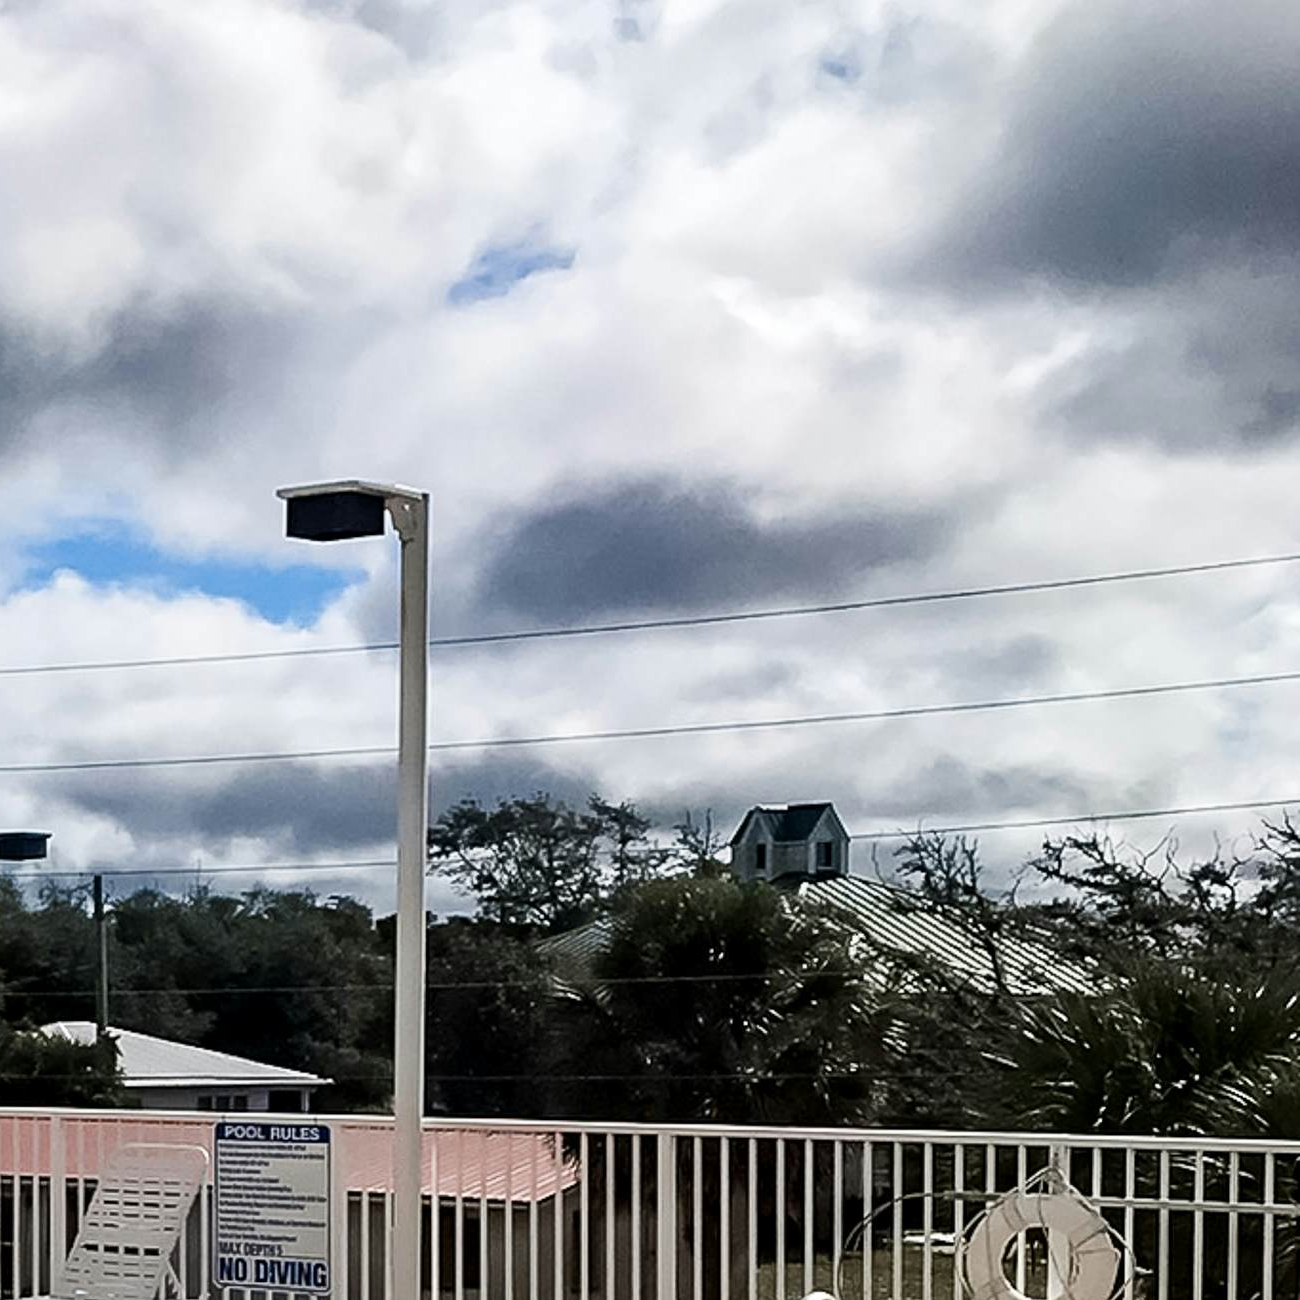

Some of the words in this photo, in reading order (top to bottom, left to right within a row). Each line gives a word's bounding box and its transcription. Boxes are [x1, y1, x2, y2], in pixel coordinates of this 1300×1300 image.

[224, 1125, 265, 1139] POOL
[270, 1127, 320, 1141] RULES
[219, 1242, 242, 1255] MAX
[244, 1243, 275, 1257] DEPTH
[219, 1257, 248, 1282] NO
[254, 1259, 327, 1287] DIVING
